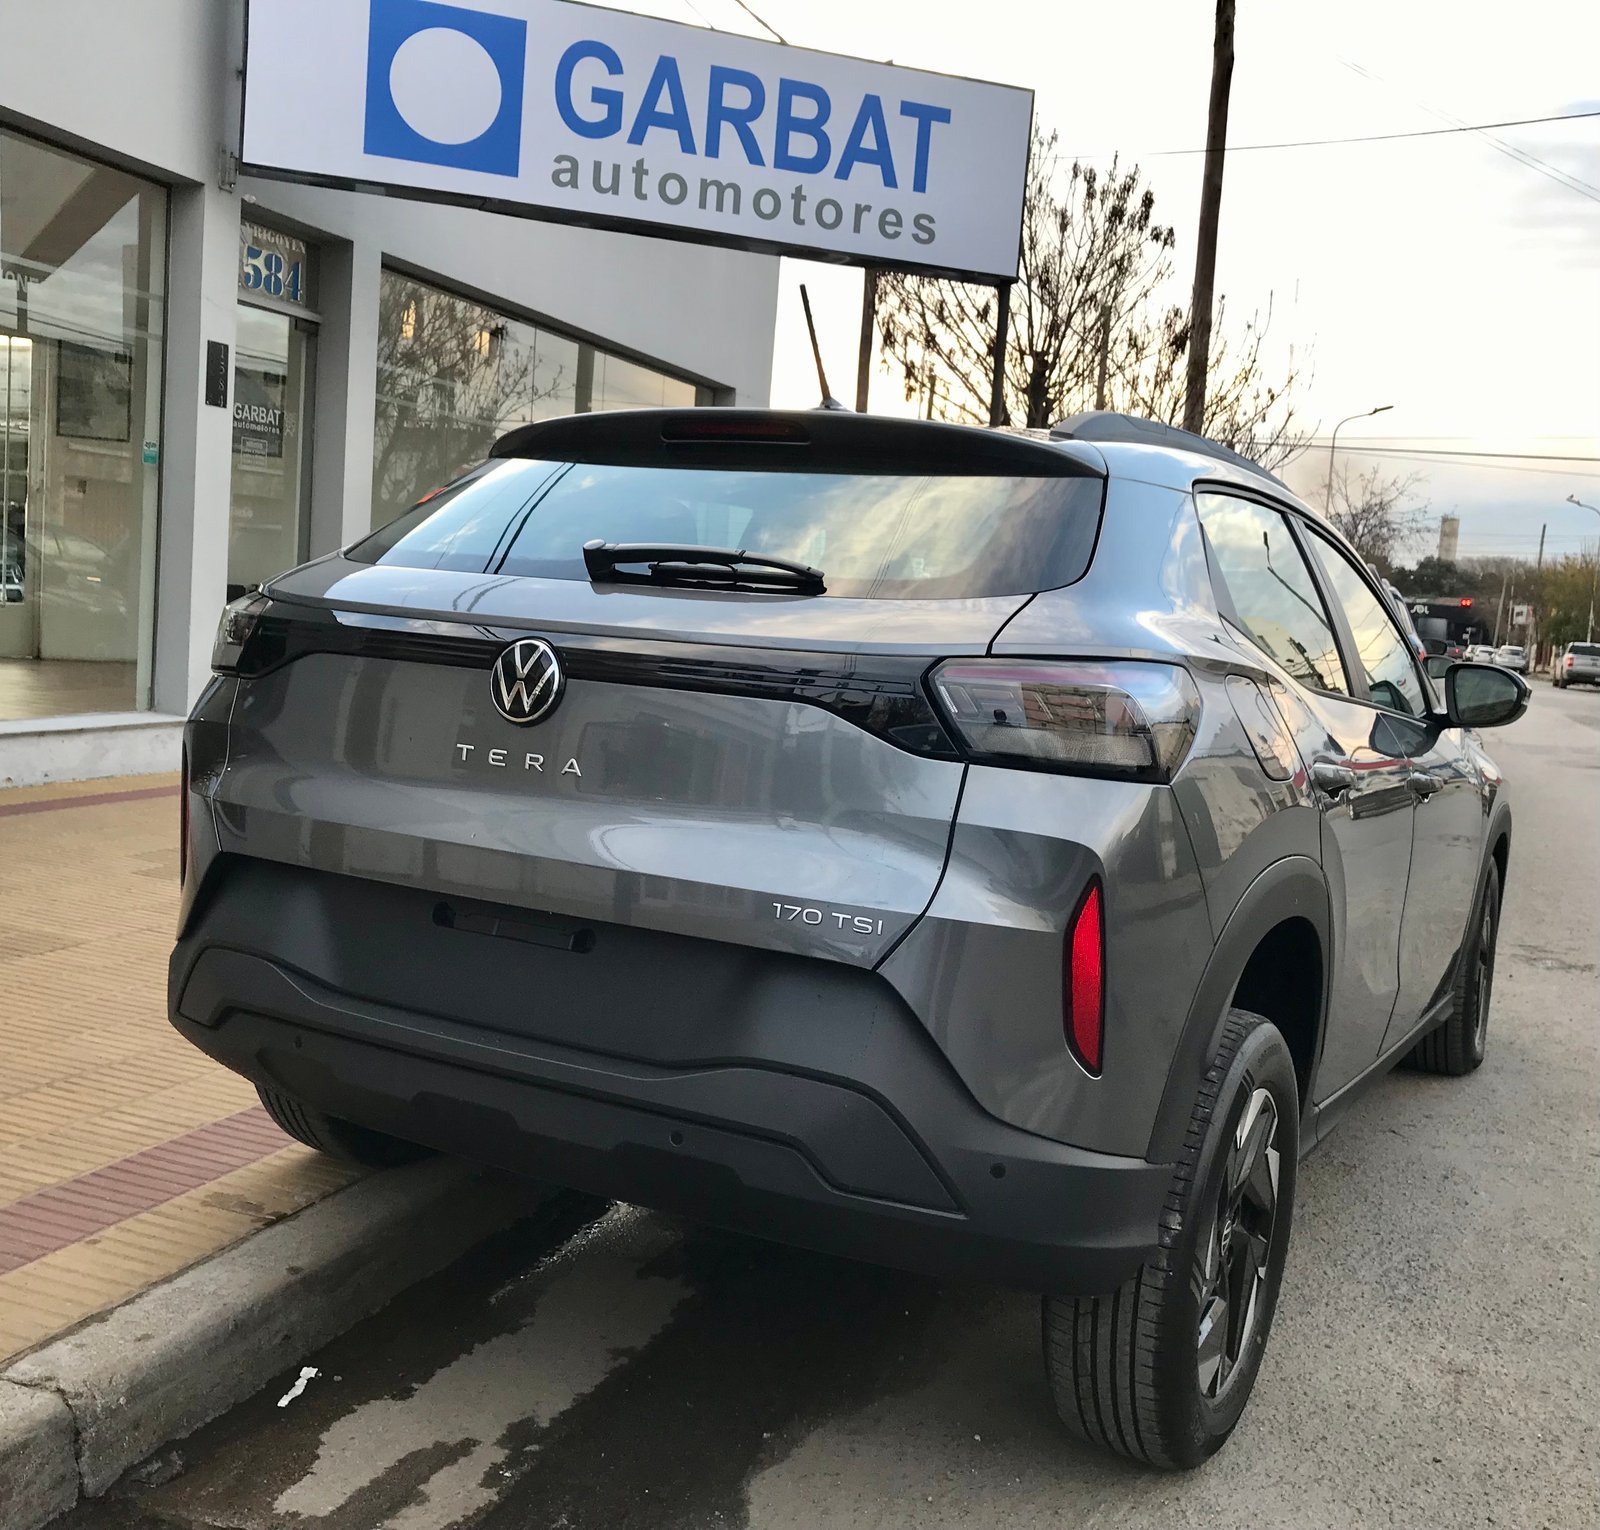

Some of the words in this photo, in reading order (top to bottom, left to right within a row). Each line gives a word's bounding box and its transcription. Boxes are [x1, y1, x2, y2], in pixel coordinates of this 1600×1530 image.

[554, 39, 952, 194] GARBAT
[551, 153, 937, 245] automotores
[233, 402, 281, 426] GARBAT
[456, 743, 582, 777] TERA
[772, 902, 823, 925] 170
[831, 912, 884, 935] TSI
